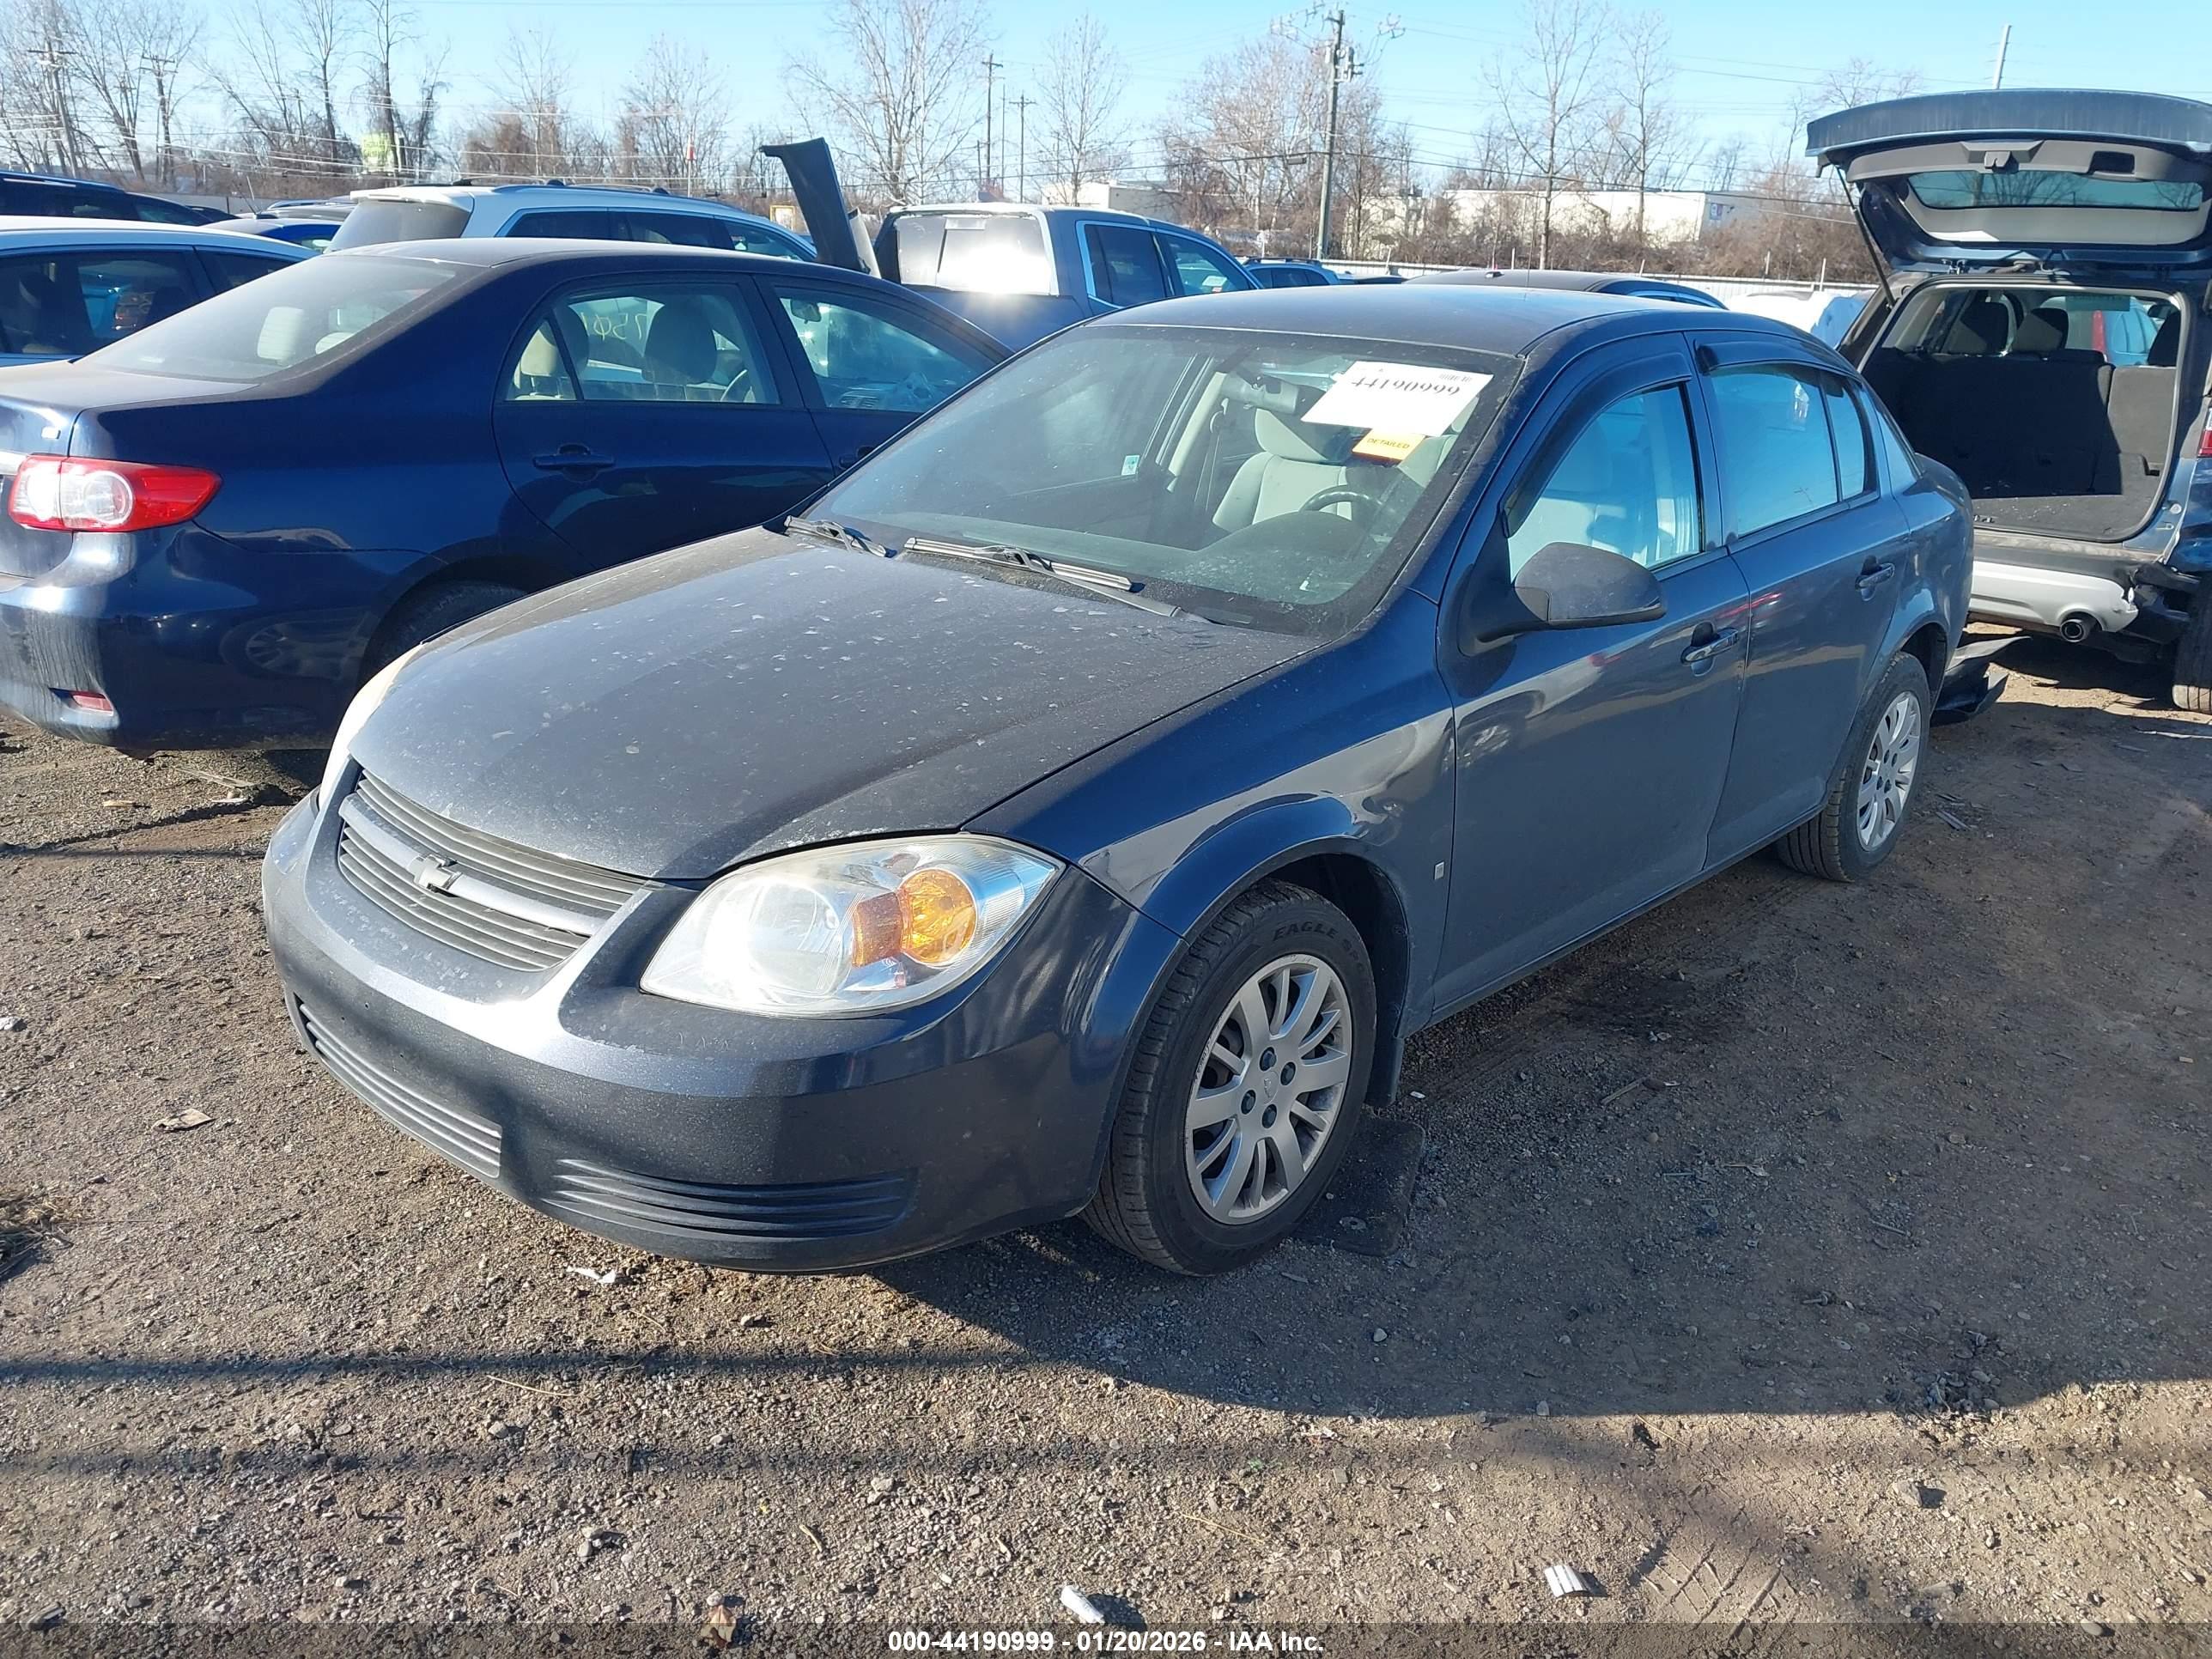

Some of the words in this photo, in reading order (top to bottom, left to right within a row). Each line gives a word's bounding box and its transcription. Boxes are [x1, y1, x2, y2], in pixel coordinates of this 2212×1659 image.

[1351, 376, 1461, 396] 44190999
[1366, 437, 1411, 450] DETAILED
[1273, 921, 1340, 941] EAGLE
